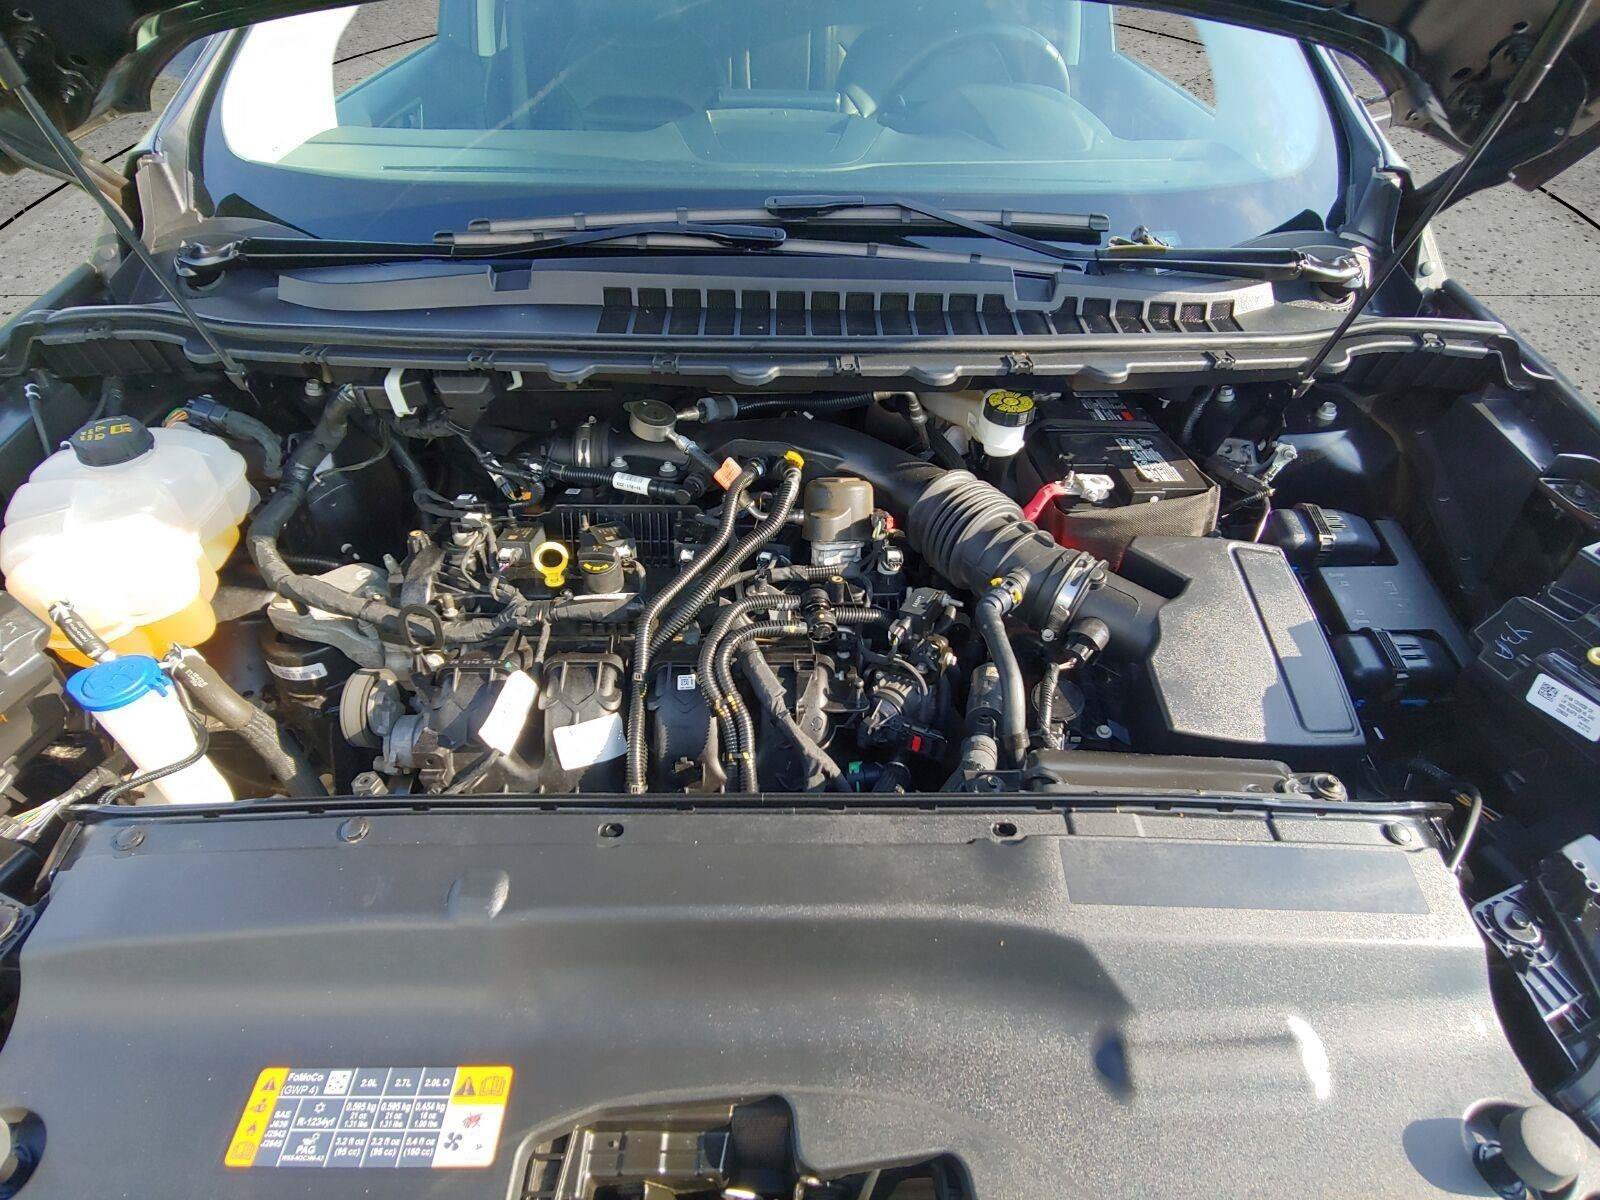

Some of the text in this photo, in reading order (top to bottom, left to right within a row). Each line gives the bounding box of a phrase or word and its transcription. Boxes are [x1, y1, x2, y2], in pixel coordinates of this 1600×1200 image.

[287, 1072, 324, 1082] FoMoCo
[360, 1078, 378, 1088] 2.0L
[394, 1078, 412, 1088] 2.7L
[424, 1078, 450, 1088] 2.0L D
[280, 1085, 319, 1096] (GWP 4)
[346, 1102, 377, 1113] 0.595 kg
[380, 1102, 412, 1113] 0.595 kg
[415, 1102, 446, 1113] 0.454 kg
[274, 1110, 292, 1118] SAE
[350, 1112, 358, 1120] 21
[384, 1112, 392, 1120] 21
[296, 1117, 336, 1128] R-1234yf
[344, 1120, 358, 1128] 1.31
[379, 1120, 392, 1128] 1.31
[335, 1136, 365, 1146] 3.2 fl oz
[370, 1136, 401, 1146] 3.2 fl oz
[419, 1136, 424, 1146] fl
[426, 1138, 436, 1146] oz
[295, 1145, 317, 1155] PAG
[348, 1147, 360, 1157] cc)
[384, 1147, 397, 1157] cc)
[421, 1147, 432, 1157] cc)
